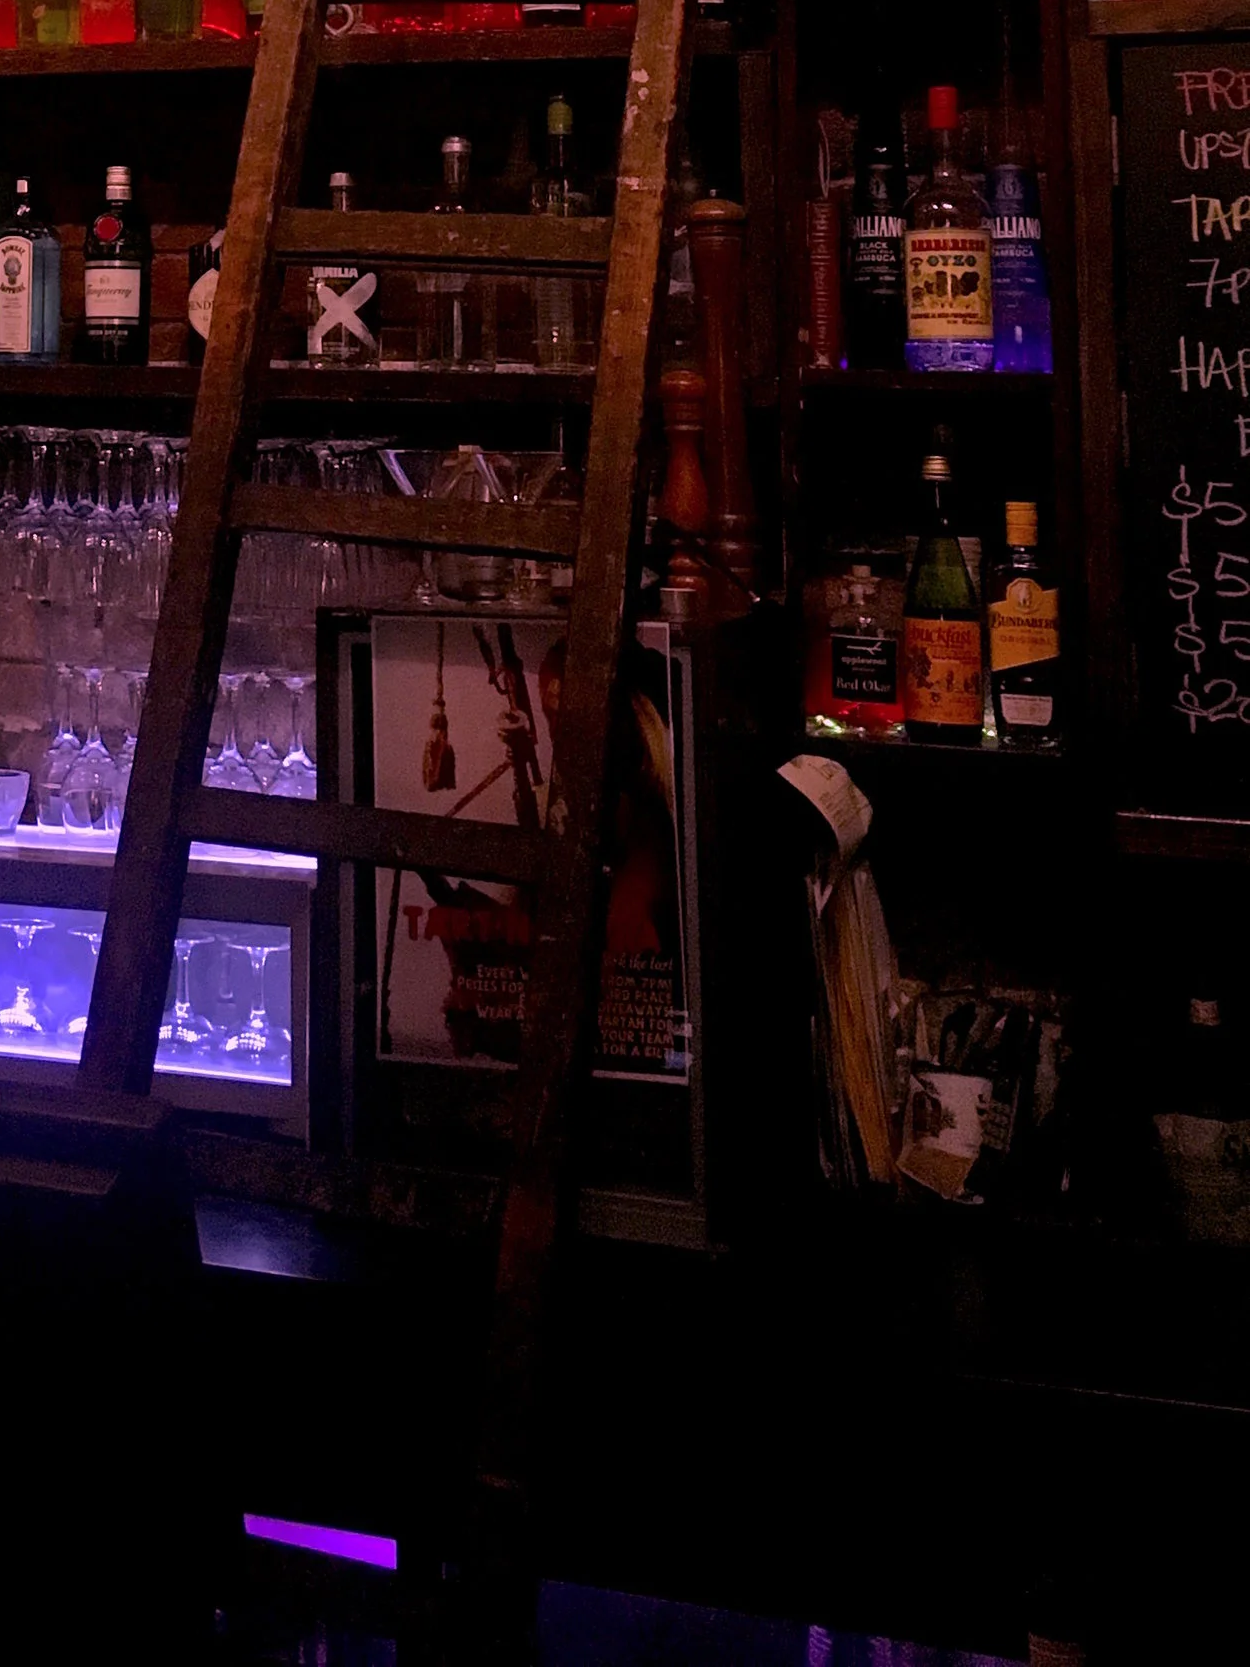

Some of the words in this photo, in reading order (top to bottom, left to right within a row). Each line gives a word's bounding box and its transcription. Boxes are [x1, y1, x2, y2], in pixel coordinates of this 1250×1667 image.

[859, 241, 889, 249] BLACK
[1, 245, 26, 255] BOMBAY
[993, 249, 1035, 257] AMBUCA
[836, 677, 859, 691] Red
